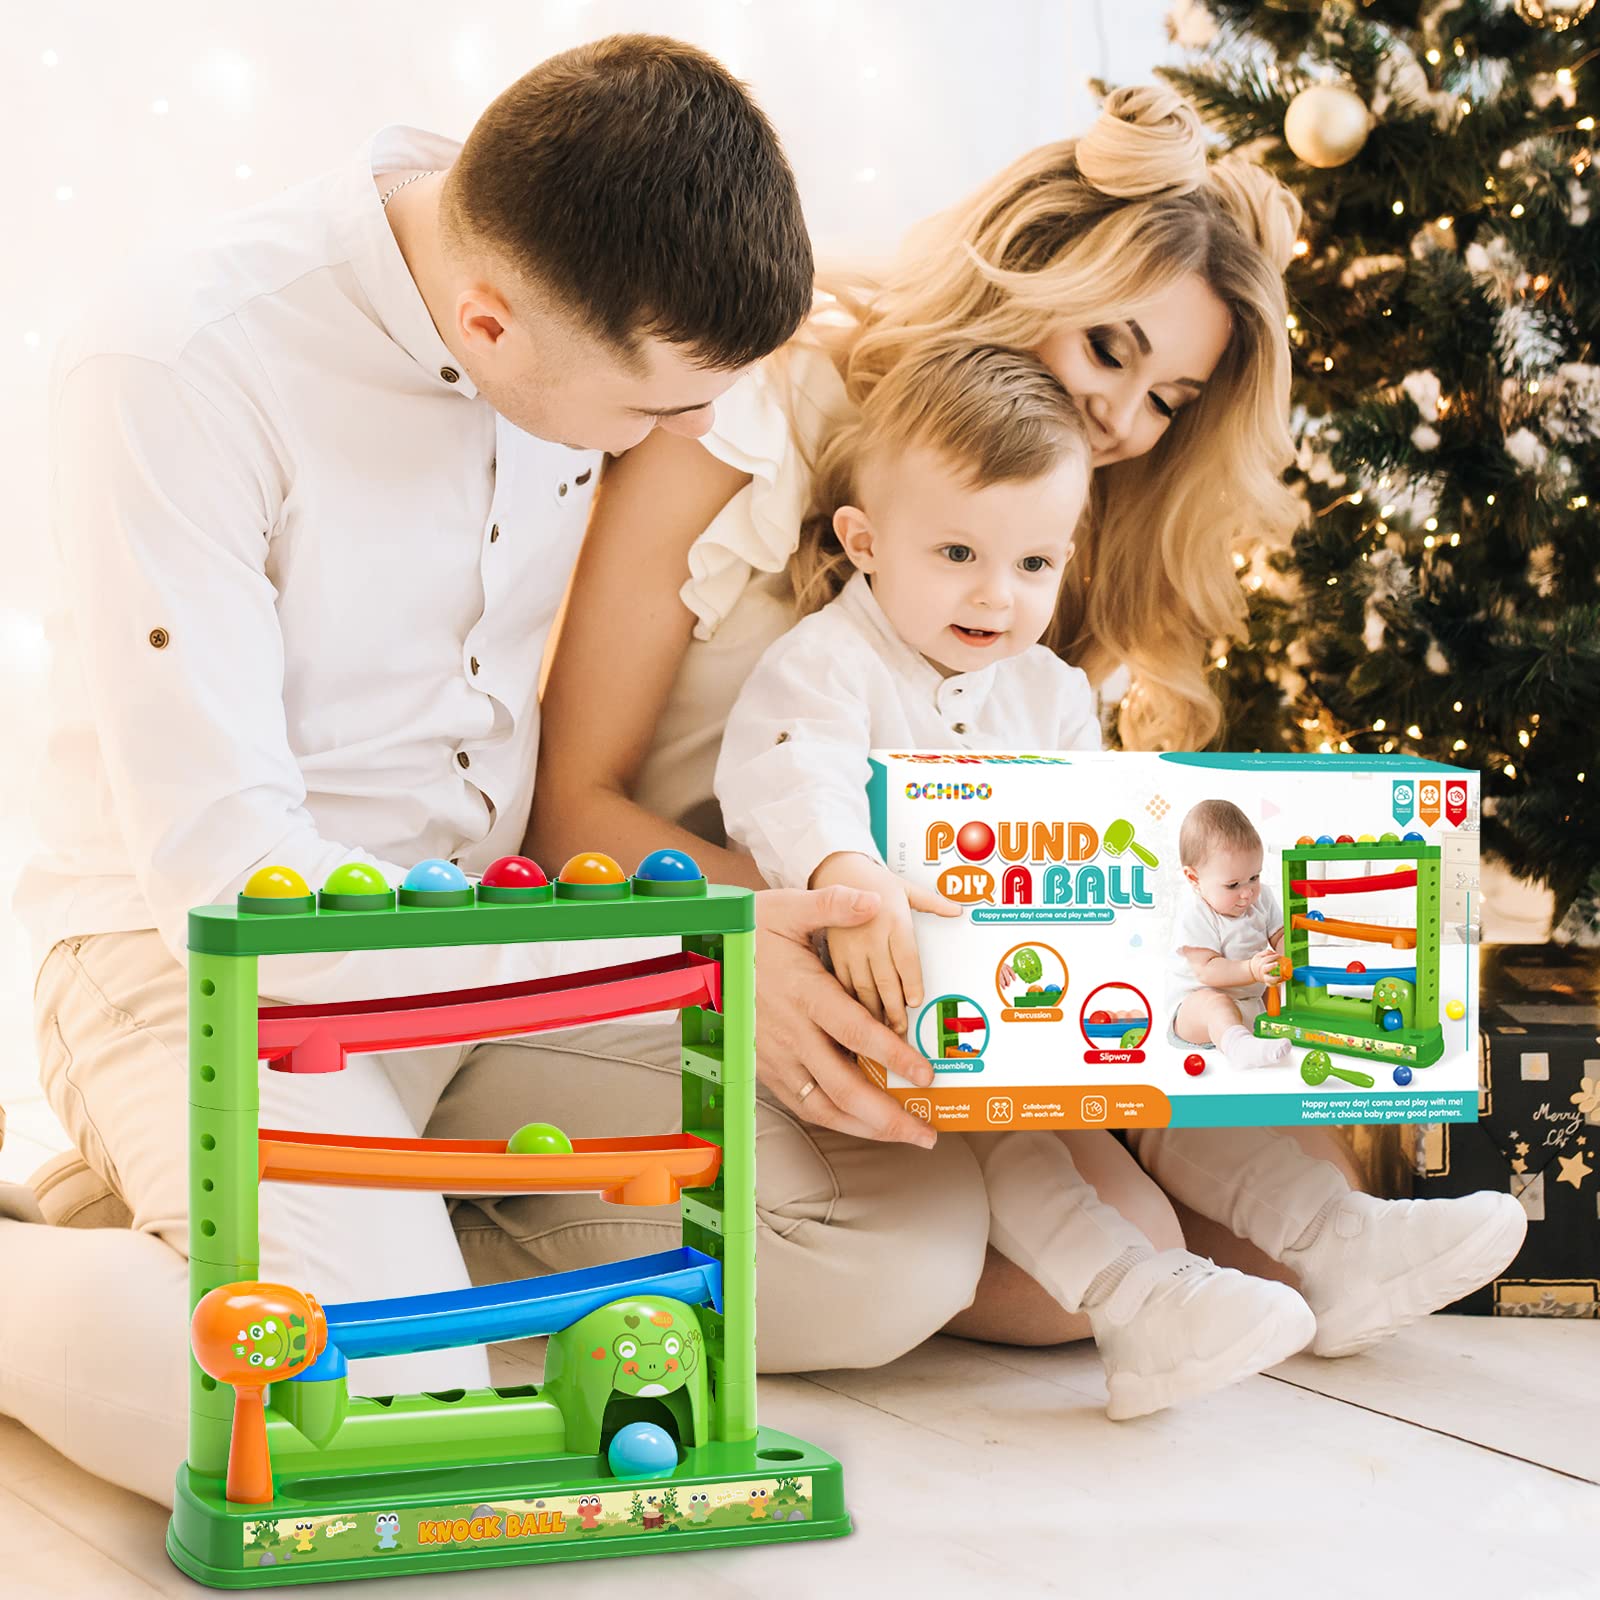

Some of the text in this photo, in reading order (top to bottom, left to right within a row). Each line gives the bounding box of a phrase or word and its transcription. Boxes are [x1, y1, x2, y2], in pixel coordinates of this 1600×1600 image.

[905, 782, 993, 800] OCHIDO
[925, 820, 1099, 861] POUND
[946, 865, 1153, 904] DIY A BALL
[979, 912, 1000, 920] Happy
[1020, 911, 1034, 919] day!
[1054, 911, 1067, 919] and
[1068, 911, 1081, 919] play
[1014, 1011, 1052, 1019] Percussion
[1099, 1052, 1132, 1062] Slipway
[932, 1062, 973, 1071] Assembling
[1022, 1103, 1061, 1111] Collaborating
[1115, 1101, 1144, 1109] Hands-on
[1301, 1100, 1328, 1109] Happy
[1329, 1101, 1351, 1109] every
[1352, 1099, 1370, 1108] day!
[1394, 1099, 1410, 1107] and
[1411, 1099, 1428, 1107] play
[1430, 1098, 1447, 1106] with
[1447, 1098, 1463, 1106] me!
[1301, 1109, 1462, 1119] Mother's choice baby grow good partners.
[1532, 1102, 1584, 1134] Merry
[418, 1511, 567, 1545] KNOCK BALL
